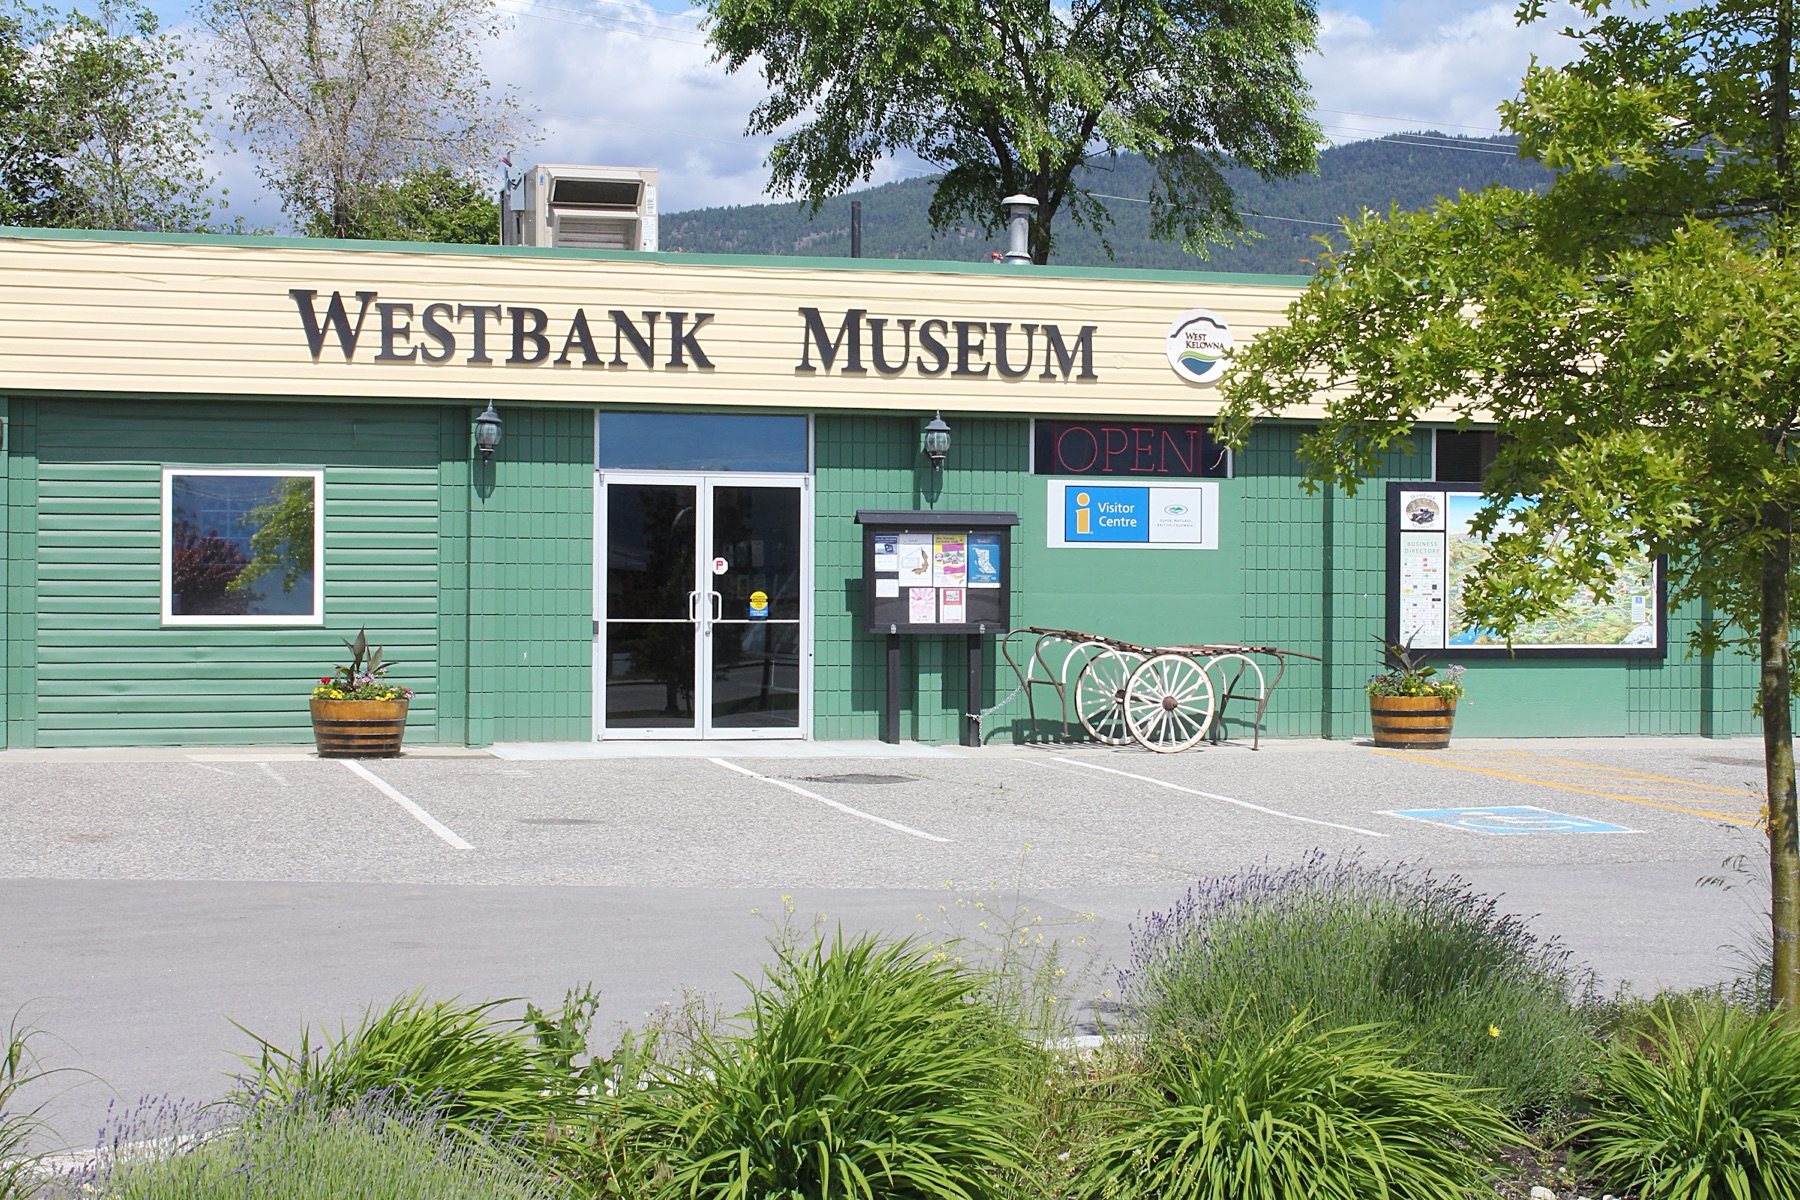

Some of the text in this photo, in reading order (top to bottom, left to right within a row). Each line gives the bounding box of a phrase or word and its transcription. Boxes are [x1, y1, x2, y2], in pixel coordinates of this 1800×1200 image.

[289, 290, 1097, 381] WESTBANK MUSEUM
[1185, 332, 1207, 341] WEST
[1185, 341, 1224, 349] KELOWNA
[1057, 426, 1198, 473] OPEN
[1098, 502, 1135, 514] Visitor
[1099, 516, 1137, 527] Centre
